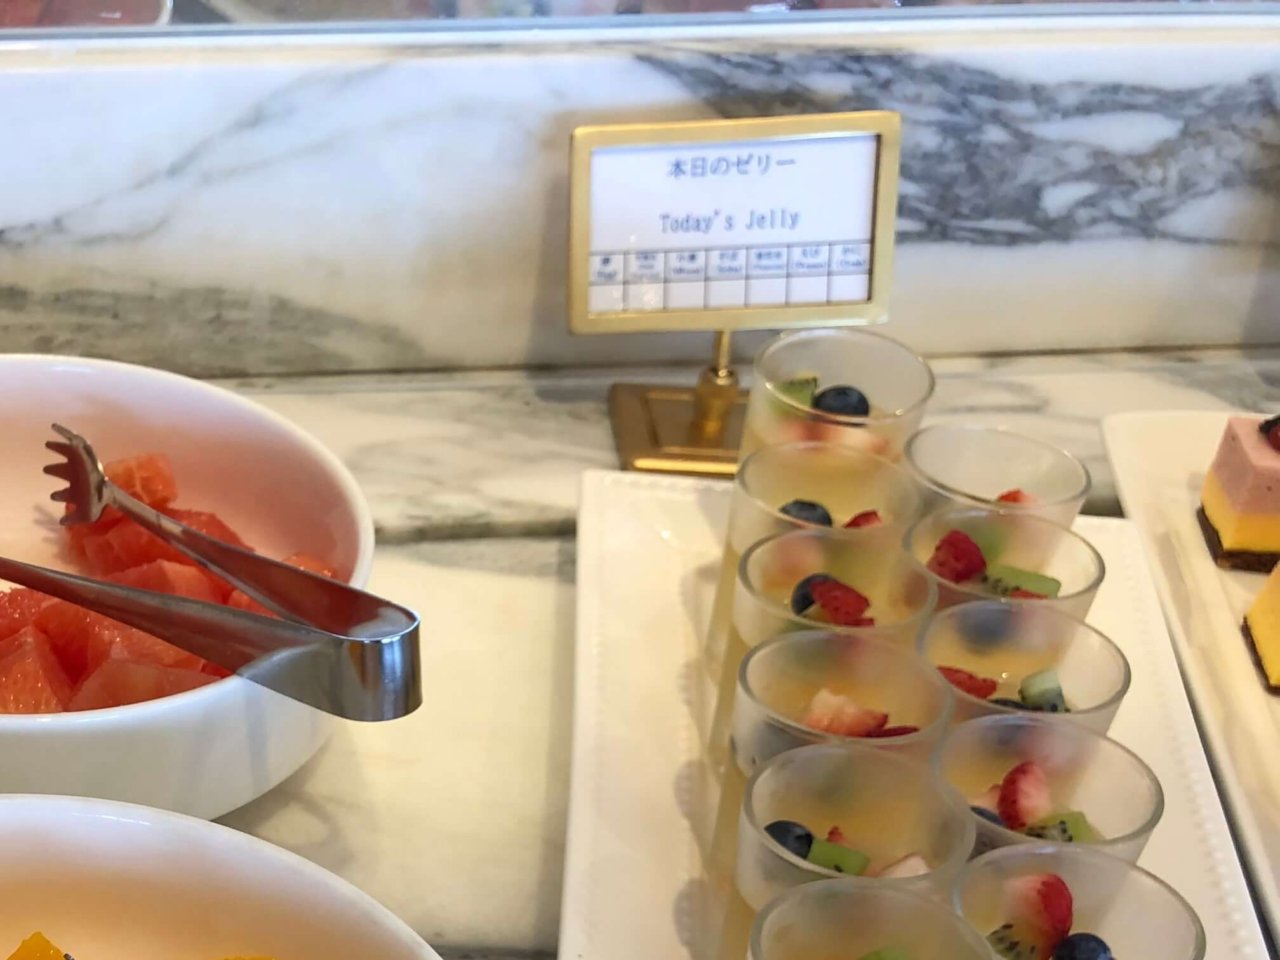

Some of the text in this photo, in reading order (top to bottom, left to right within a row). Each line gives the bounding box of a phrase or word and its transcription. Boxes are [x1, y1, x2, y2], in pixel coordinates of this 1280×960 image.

[666, 153, 796, 179] 本日のゼリー
[659, 207, 802, 234] Today's Jelly
